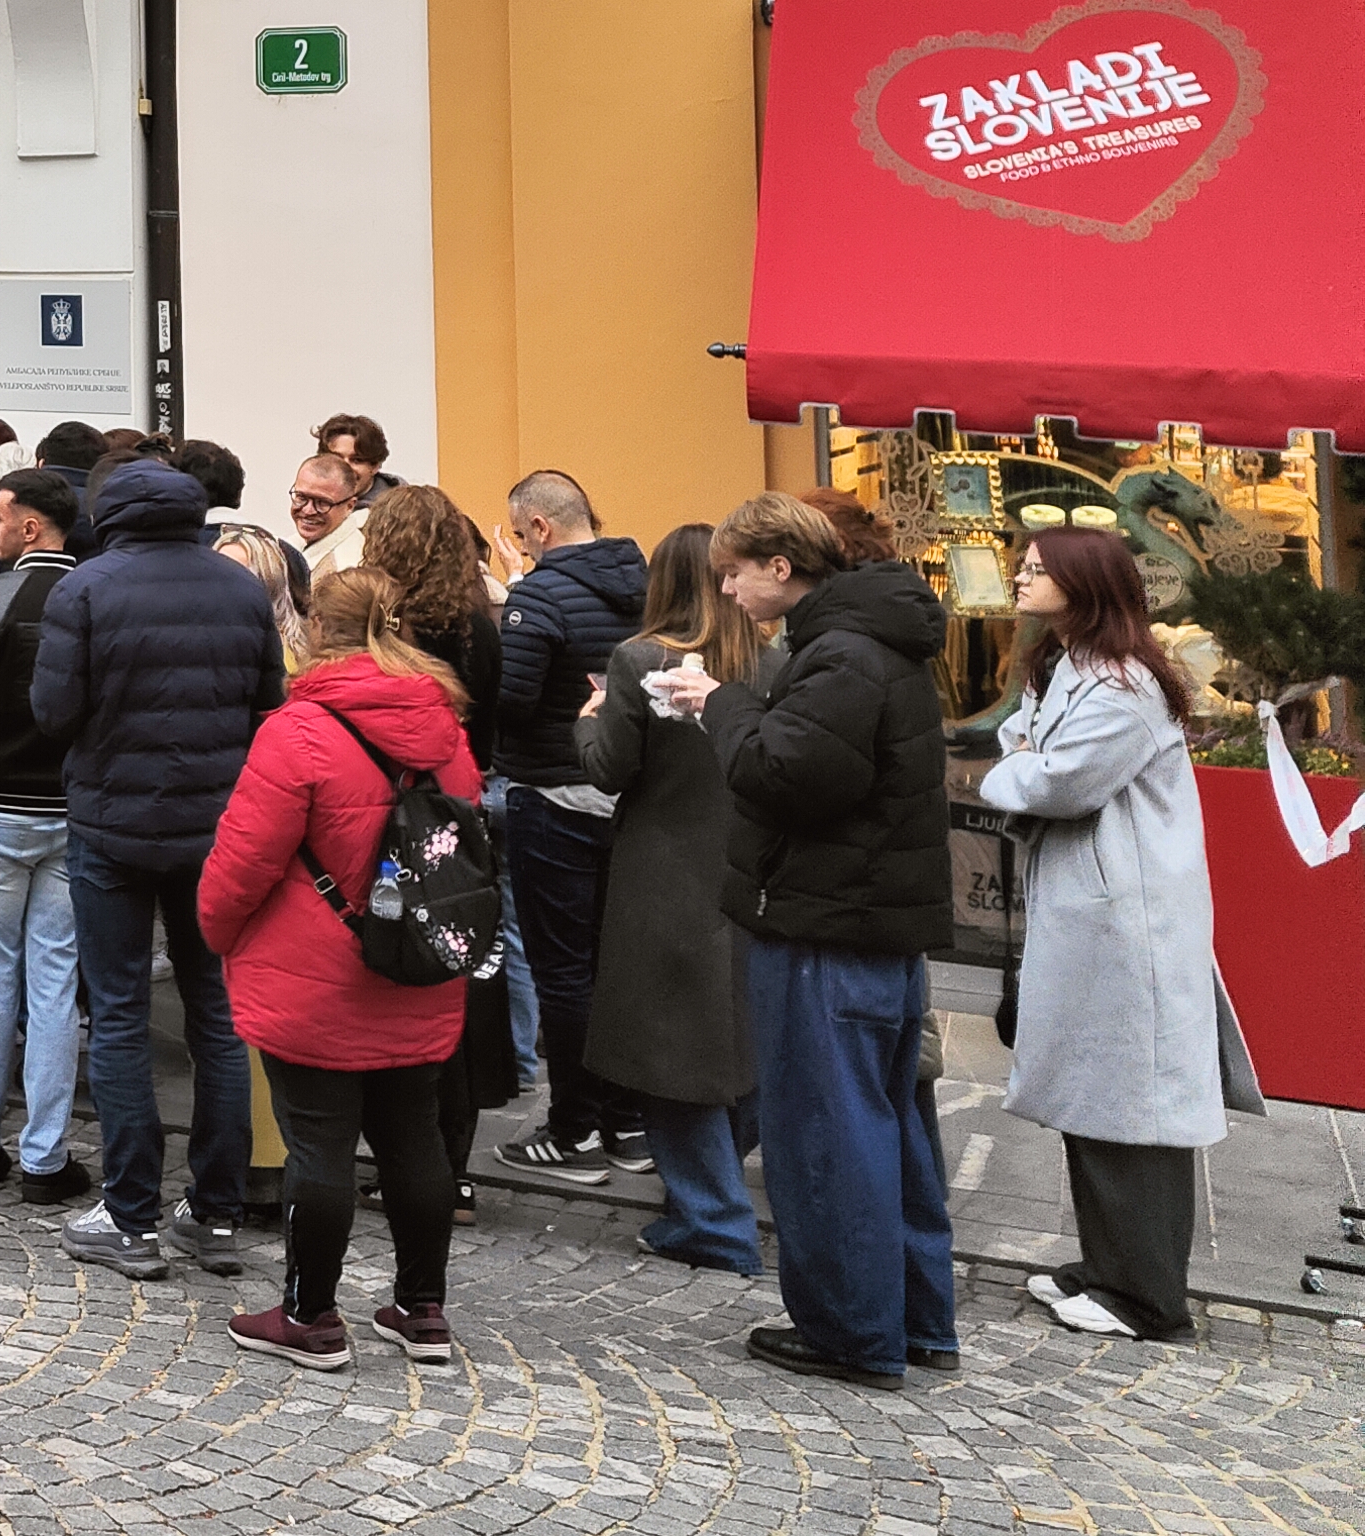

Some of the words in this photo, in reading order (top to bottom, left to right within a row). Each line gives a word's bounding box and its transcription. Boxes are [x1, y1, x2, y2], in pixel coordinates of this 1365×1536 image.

[272, 72, 320, 83] Ciril-Metodov
[294, 39, 309, 70] 2
[919, 41, 1177, 130] ZAKLADI
[925, 71, 1212, 162] SLOVENIJE
[963, 140, 1079, 179] SLOVENIA'S
[1082, 115, 1202, 152] TREASURES
[1000, 164, 1041, 183] FOOD
[1042, 160, 1052, 173] &
[1052, 151, 1101, 172] ETHNO
[1102, 134, 1180, 161] SOUVENIRS
